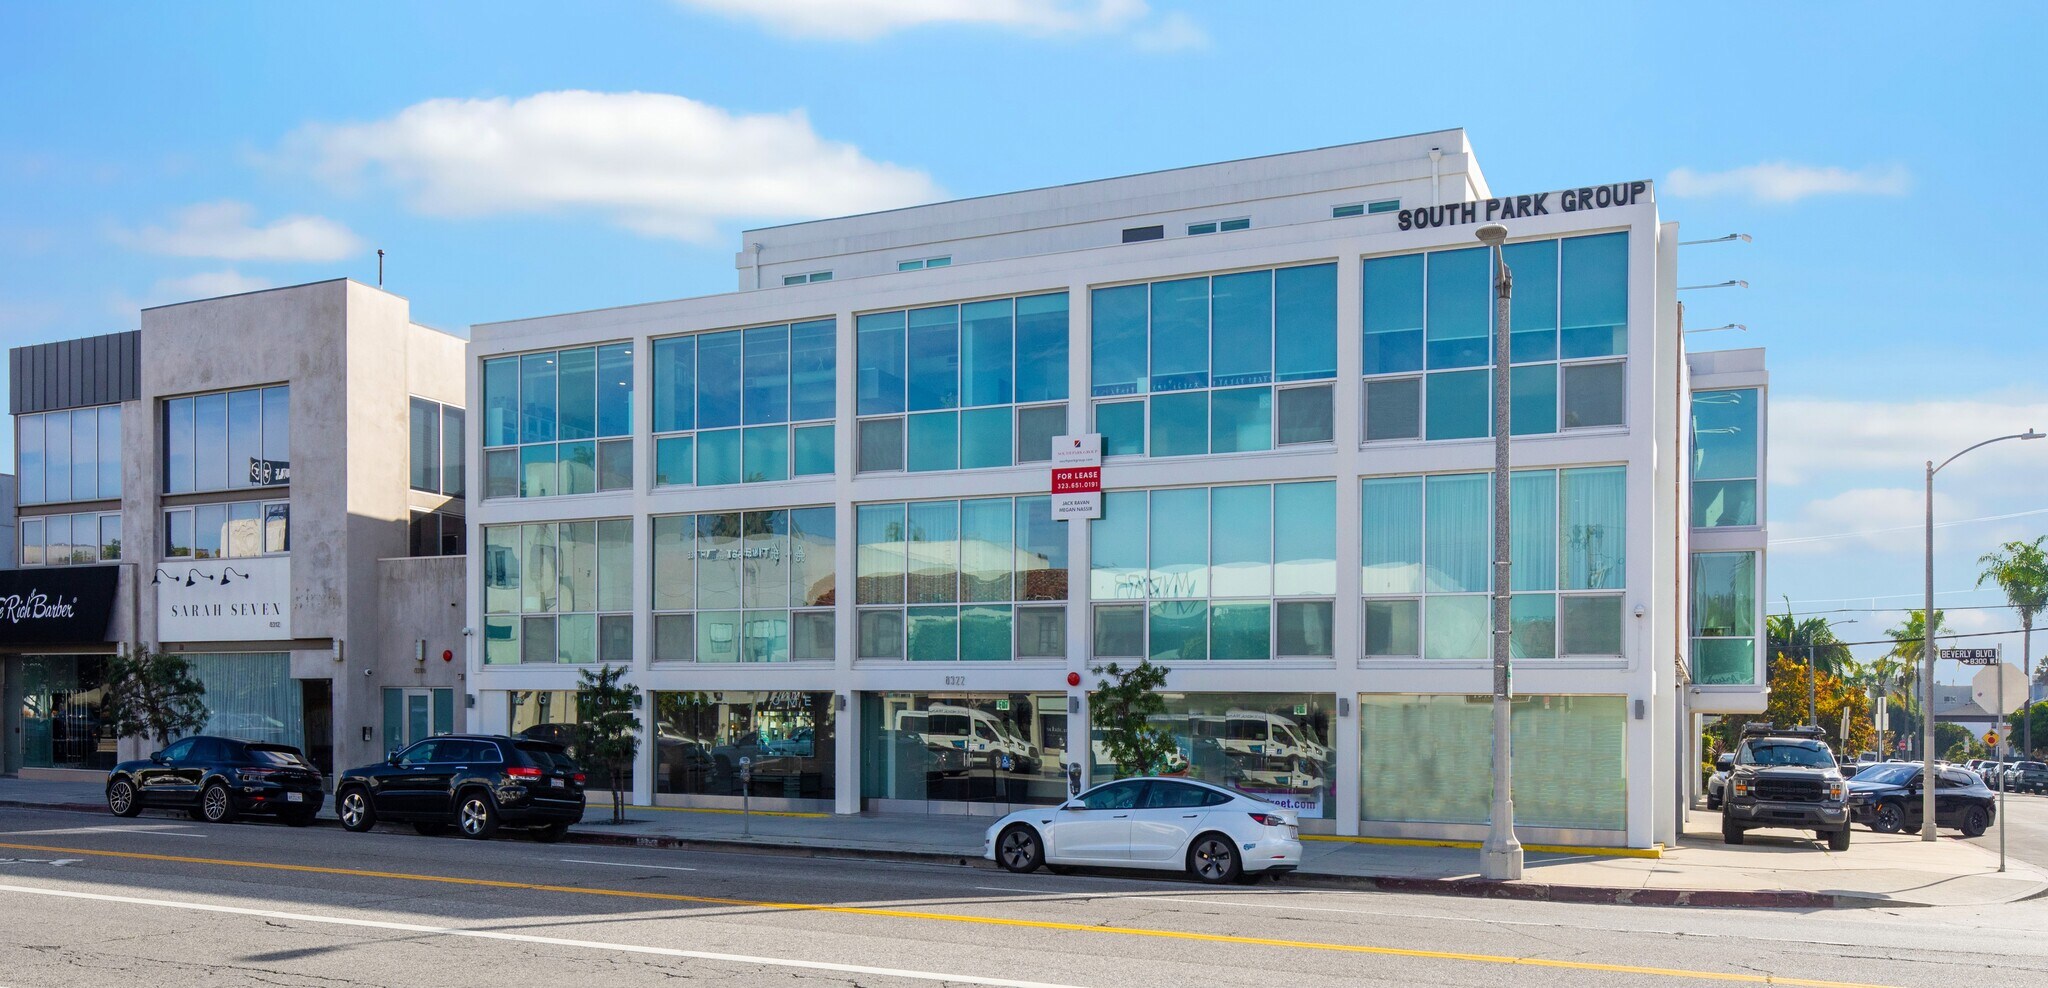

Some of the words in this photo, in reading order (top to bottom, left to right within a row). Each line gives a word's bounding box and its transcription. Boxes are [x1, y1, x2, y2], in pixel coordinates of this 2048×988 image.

[1397, 200, 1476, 231] SOUTH
[1486, 192, 1549, 221] PARK
[1561, 181, 1646, 212] GROUP
[1074, 471, 1098, 479] LEASE
[1057, 481, 1098, 489] 323.651.0191
[4, 594, 31, 624] Rich
[30, 593, 75, 619] Barber
[171, 604, 221, 617] SARAH
[230, 603, 281, 616] SEVEN
[1941, 650, 1972, 659] BEVERLY
[1975, 649, 1995, 658] BLVD.
[945, 675, 966, 686] 8322
[1266, 798, 1316, 810] eet.com
